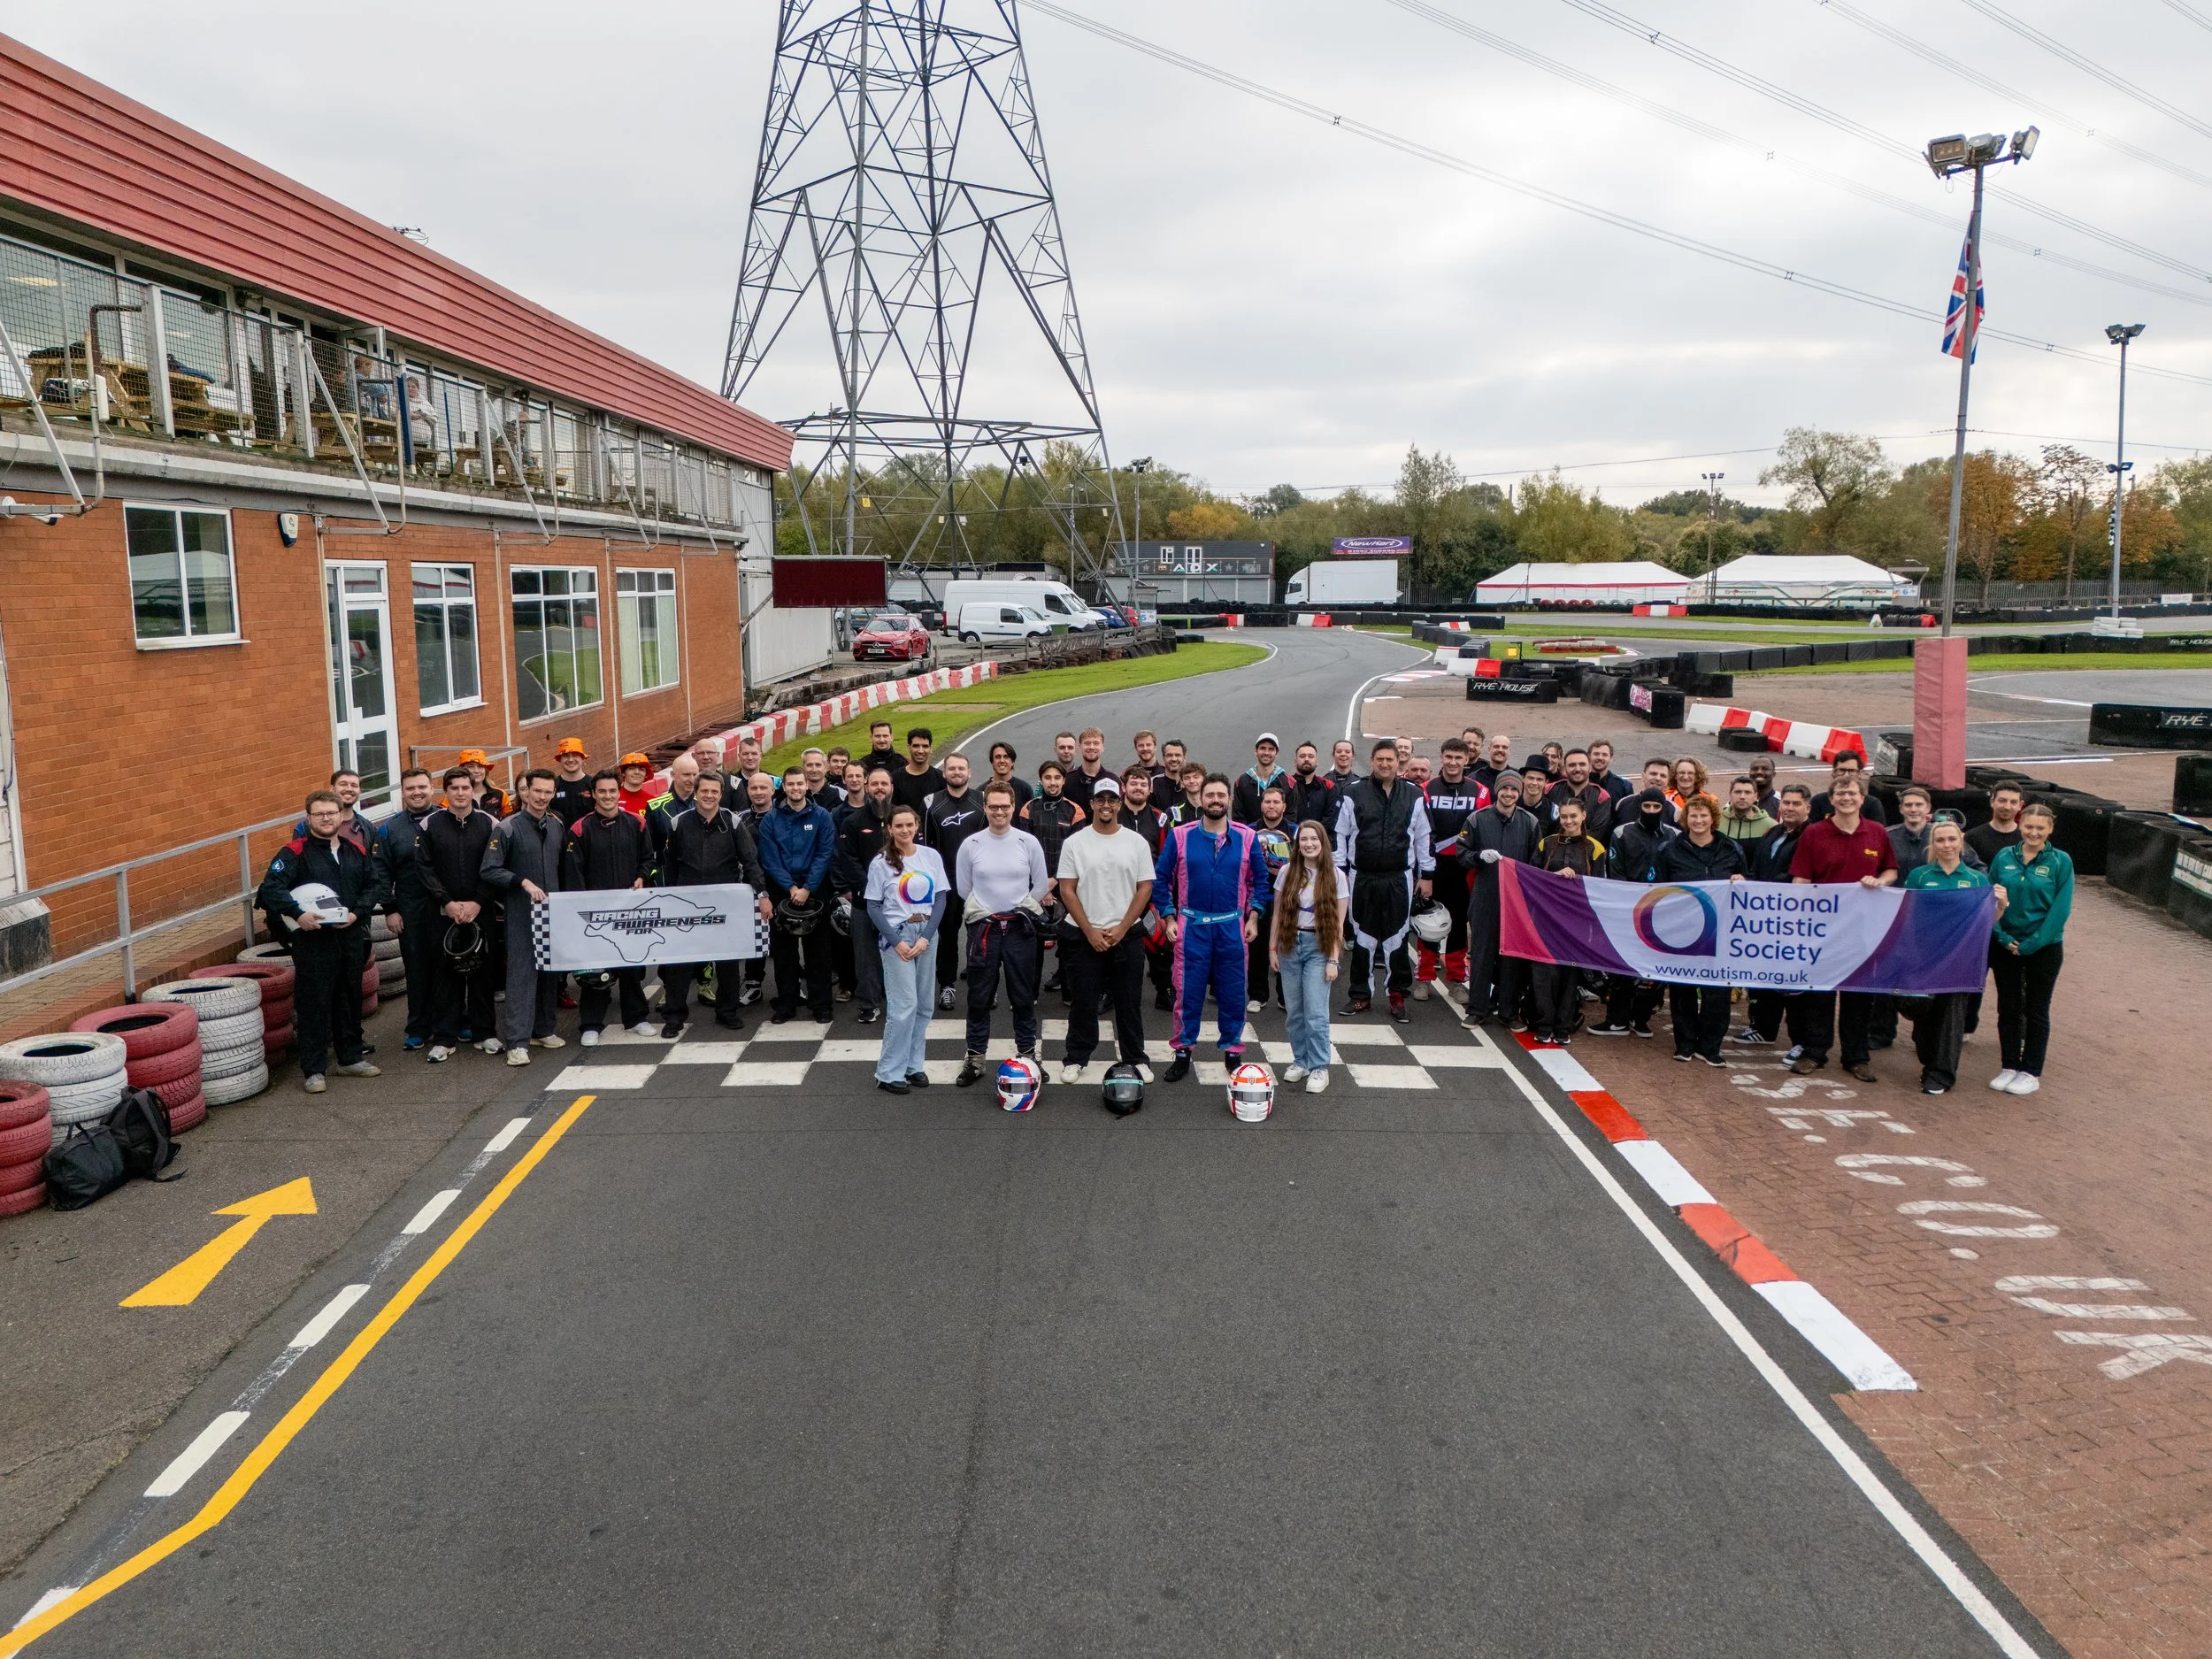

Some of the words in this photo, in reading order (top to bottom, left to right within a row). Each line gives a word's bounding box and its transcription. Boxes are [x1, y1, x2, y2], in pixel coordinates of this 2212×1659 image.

[1499, 682, 1539, 692] HOUSE
[2165, 715, 2208, 726] RYE
[1431, 795, 1476, 810] 1601
[1731, 891, 1839, 914] National
[592, 909, 660, 922] RACING
[614, 916, 725, 930] AWARENESS
[1730, 915, 1827, 938] Autistic
[1729, 939, 1823, 965] Society
[1655, 965, 1809, 985] www.autism.org.uk
